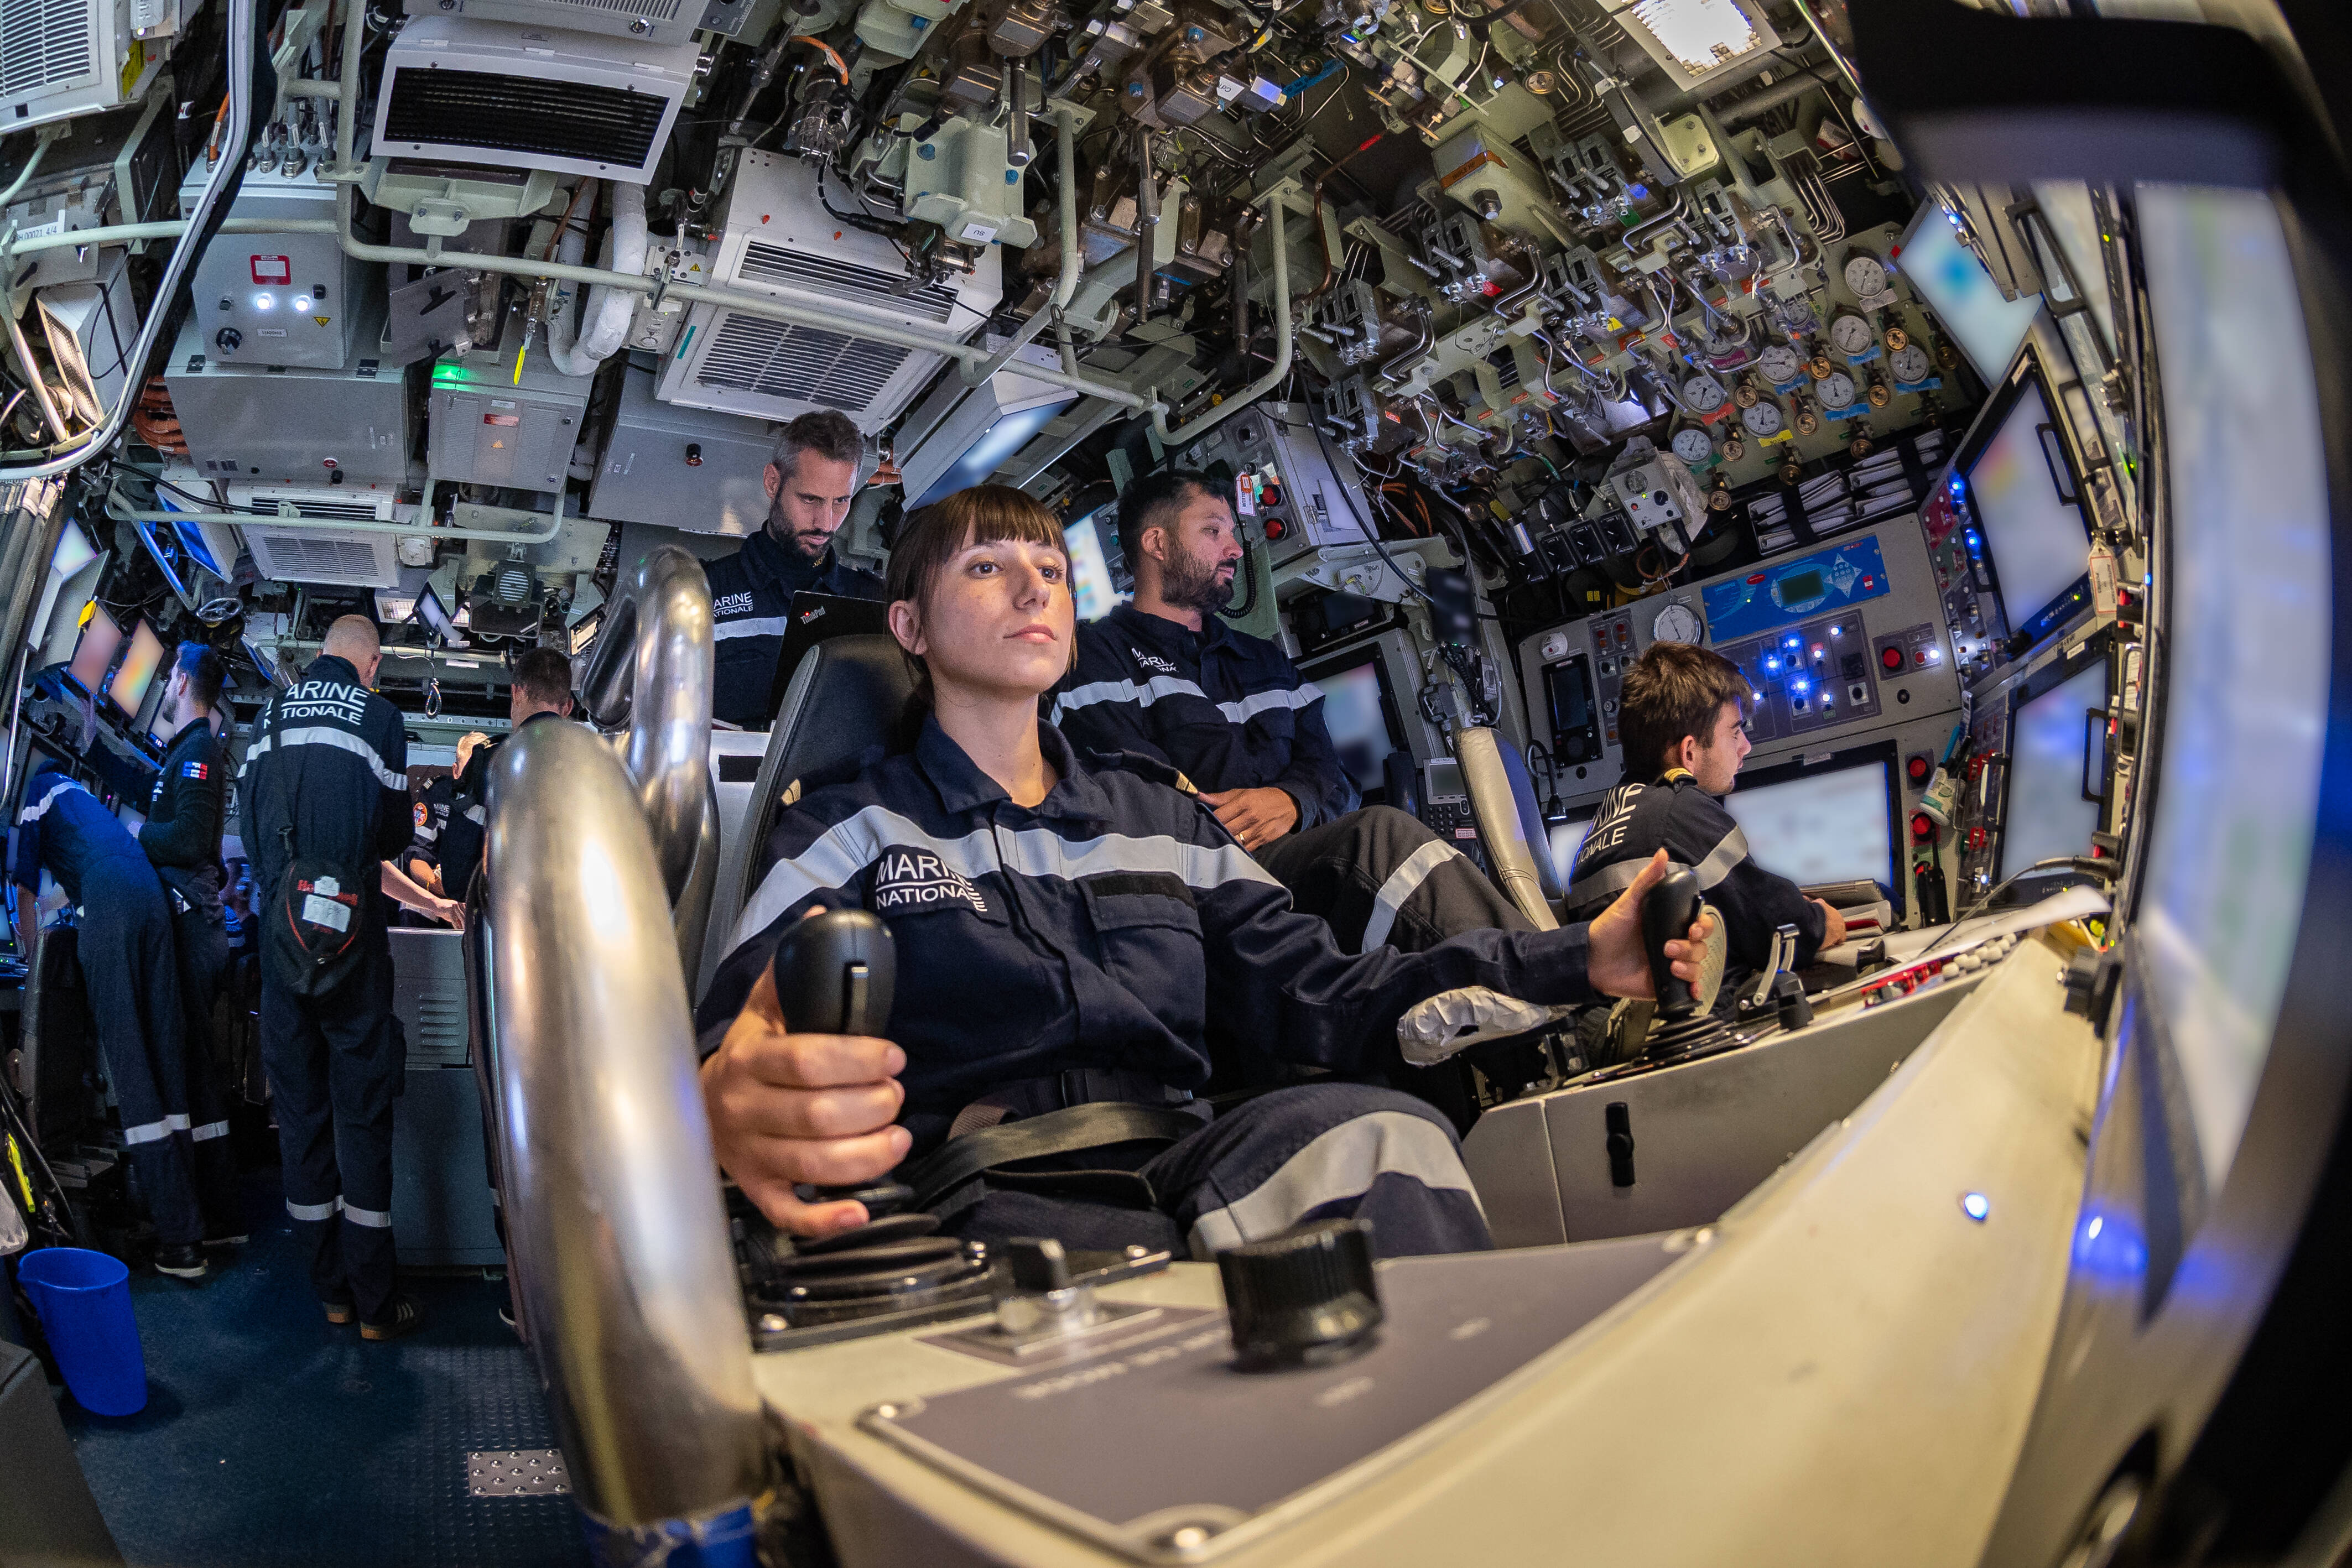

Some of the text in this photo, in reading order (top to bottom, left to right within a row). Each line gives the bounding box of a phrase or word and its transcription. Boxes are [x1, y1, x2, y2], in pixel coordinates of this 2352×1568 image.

[714, 591, 753, 610] ARINE
[714, 604, 754, 618] TIONALE
[800, 606, 826, 625] ThinkPad
[267, 680, 371, 710] ARINE
[263, 705, 363, 729] TIONALE
[1591, 783, 1646, 833] RINE
[1576, 826, 1628, 866] IONALE
